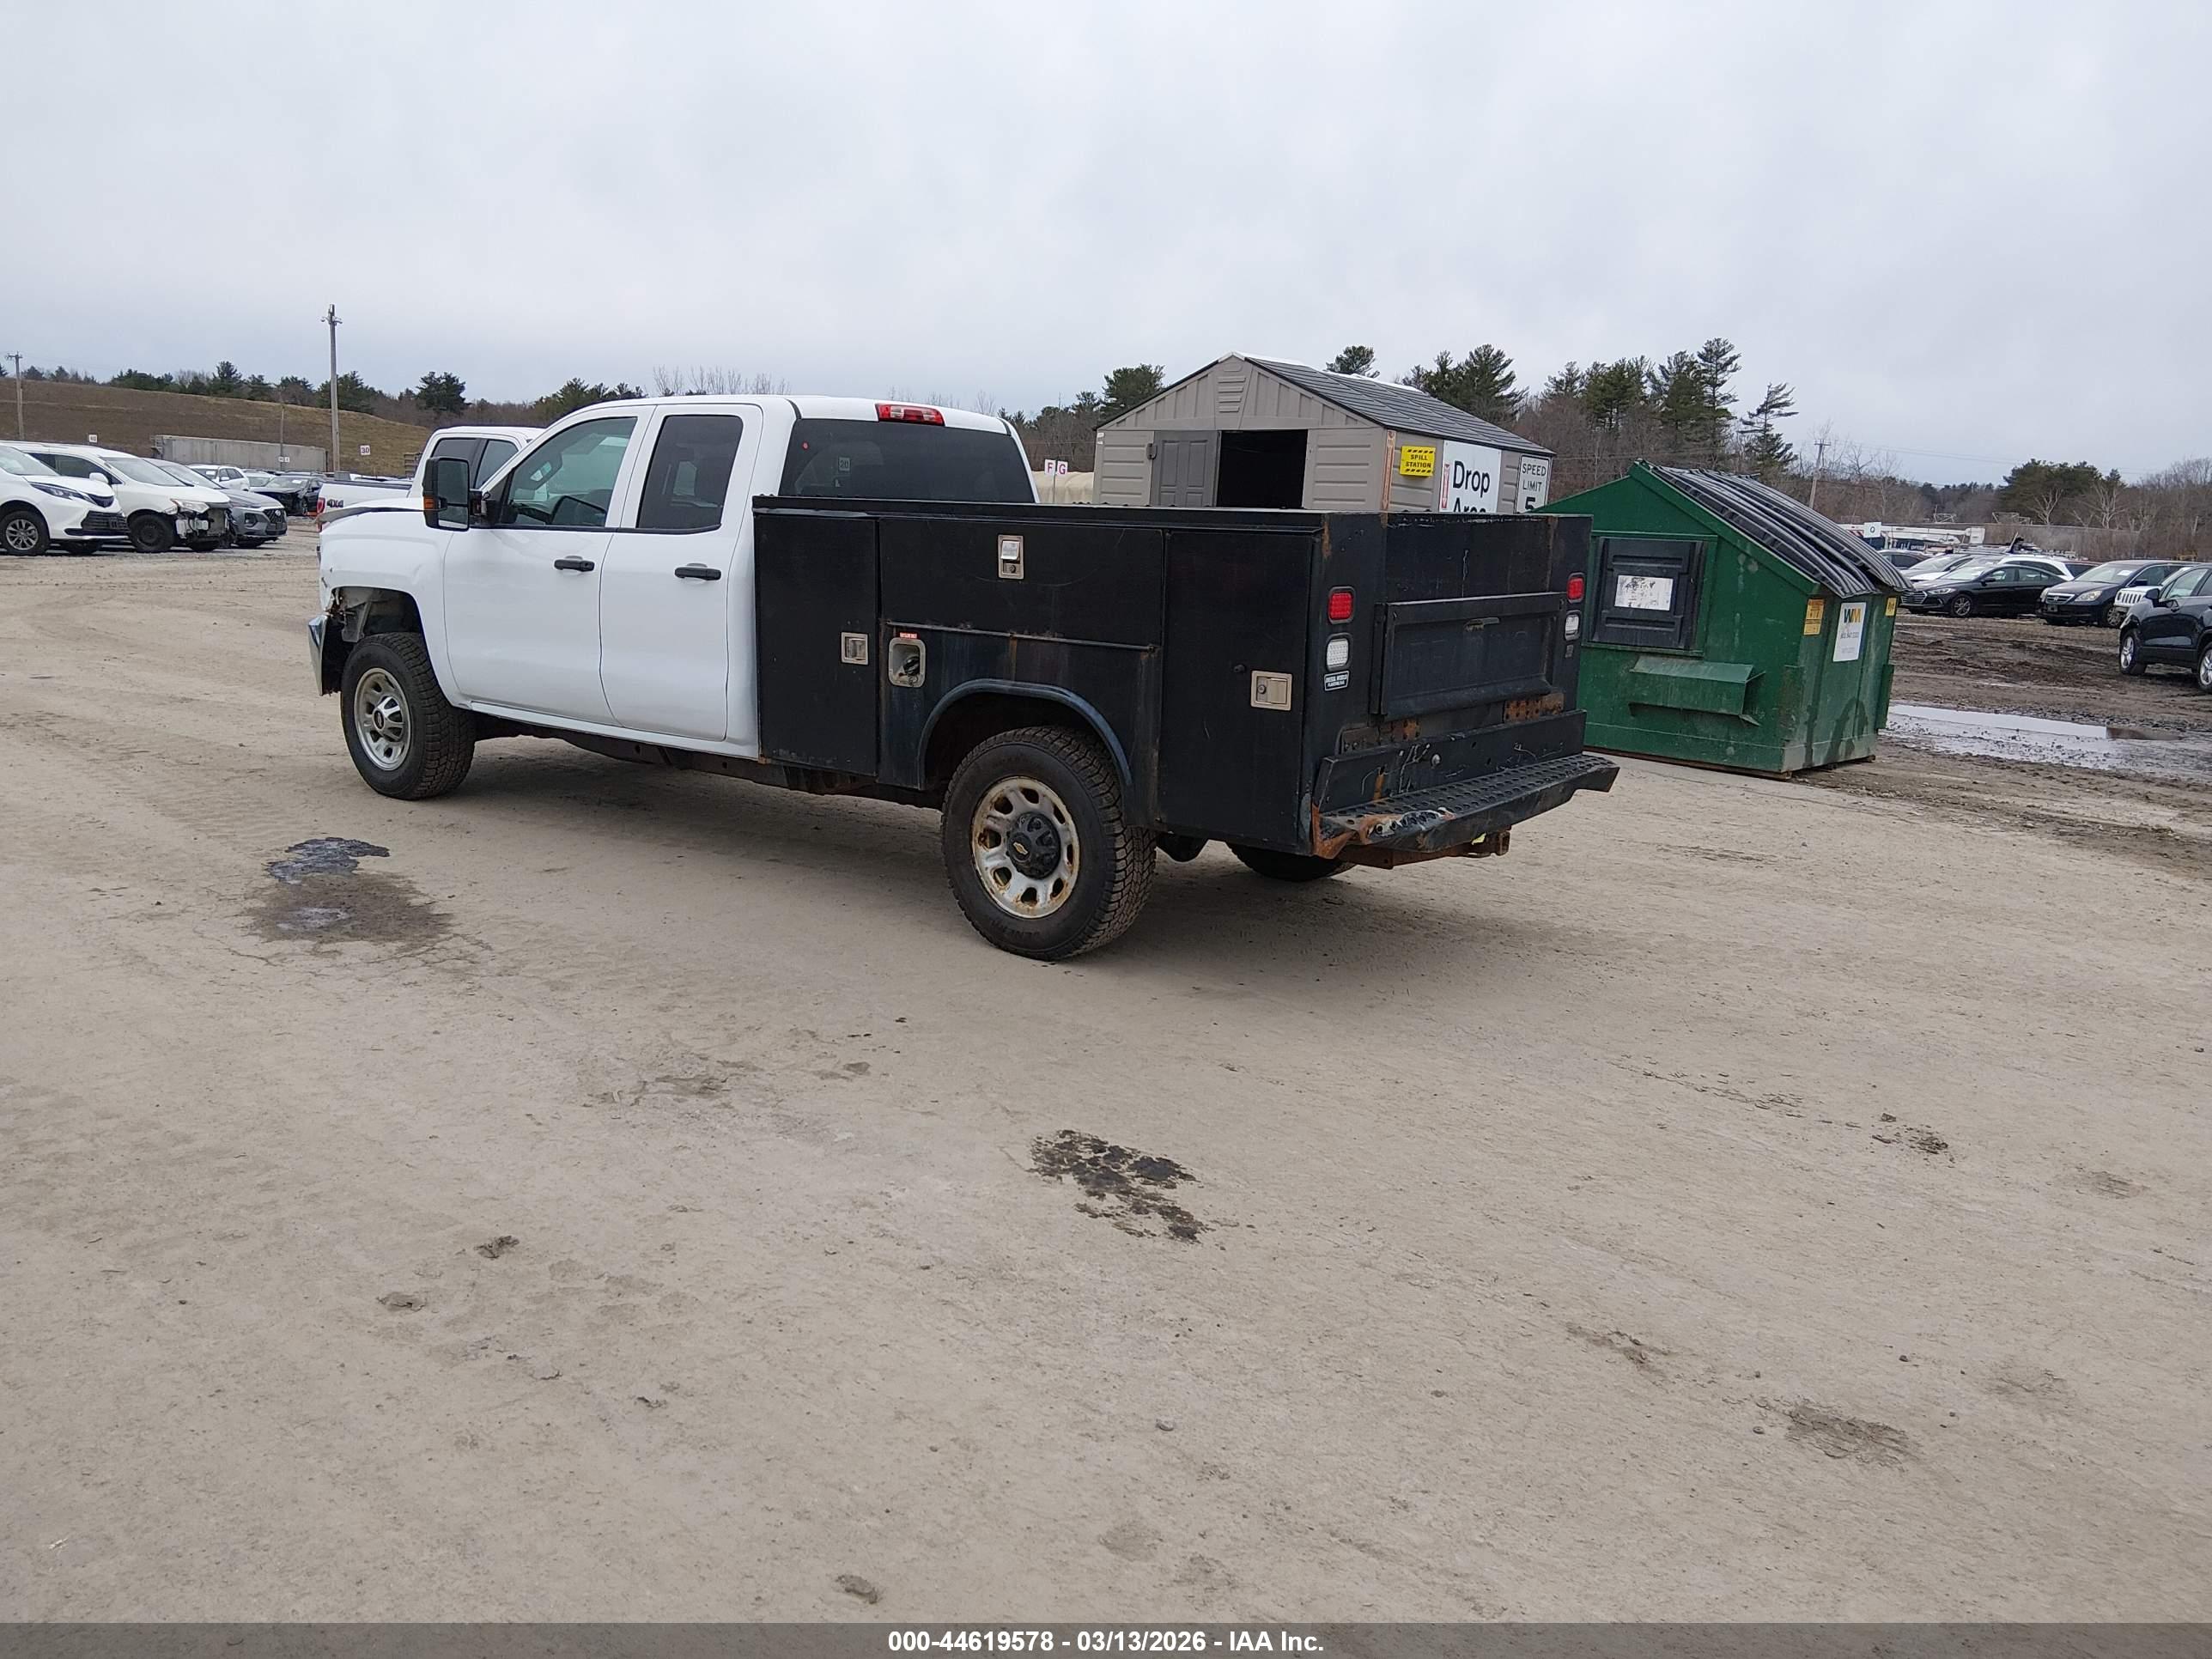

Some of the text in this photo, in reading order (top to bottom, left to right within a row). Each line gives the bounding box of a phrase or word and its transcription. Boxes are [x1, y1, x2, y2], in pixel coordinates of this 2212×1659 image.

[1047, 462, 1054, 474] F
[1059, 463, 1066, 475] G
[1522, 463, 1547, 477] SPEED
[1453, 460, 1490, 498] Drop
[1522, 479, 1542, 491] LIMIT
[1844, 608, 1862, 623] WM
